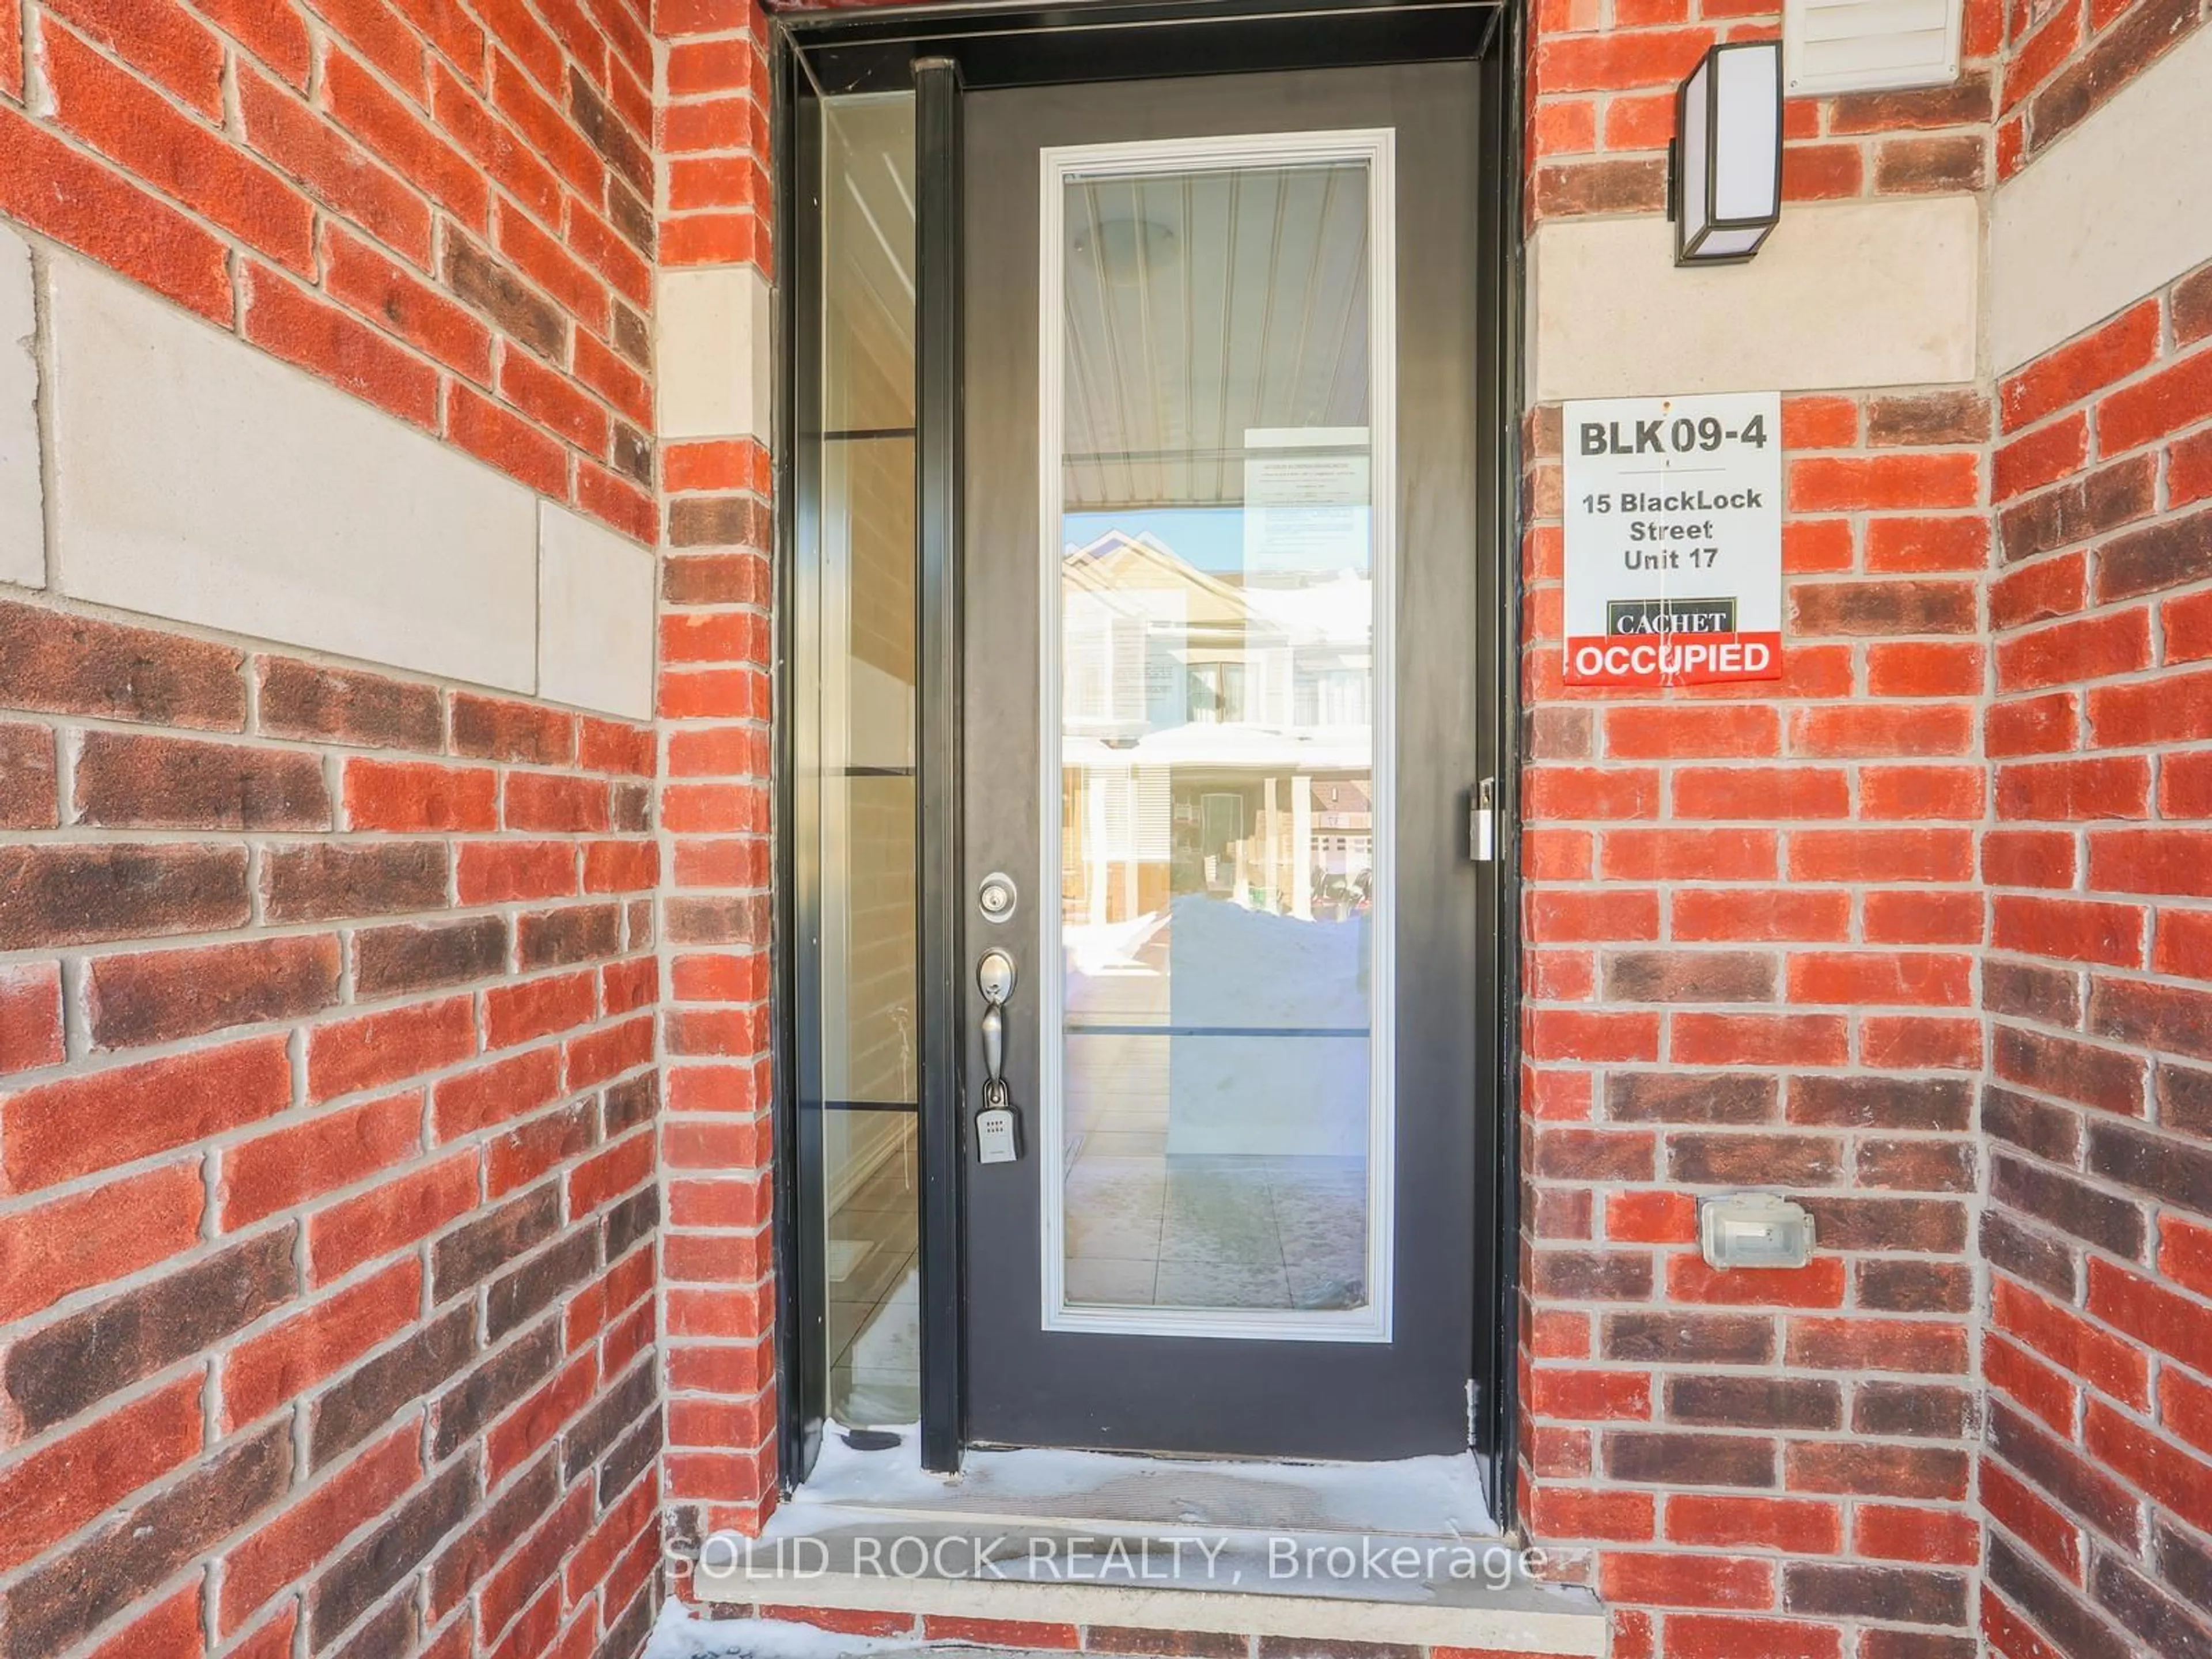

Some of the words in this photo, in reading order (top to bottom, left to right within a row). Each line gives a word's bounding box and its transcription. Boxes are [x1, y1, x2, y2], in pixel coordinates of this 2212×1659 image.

[1580, 419, 1665, 456] BLK
[1672, 414, 1767, 453] 09-4
[1583, 494, 1611, 513] 15
[1620, 488, 1763, 512] BlackLock
[1630, 520, 1713, 541] Street
[1624, 550, 1679, 570] Unit
[1690, 548, 1719, 568] 17
[1616, 613, 1726, 634] CACHET
[1575, 643, 1770, 675] OCCUPIED
